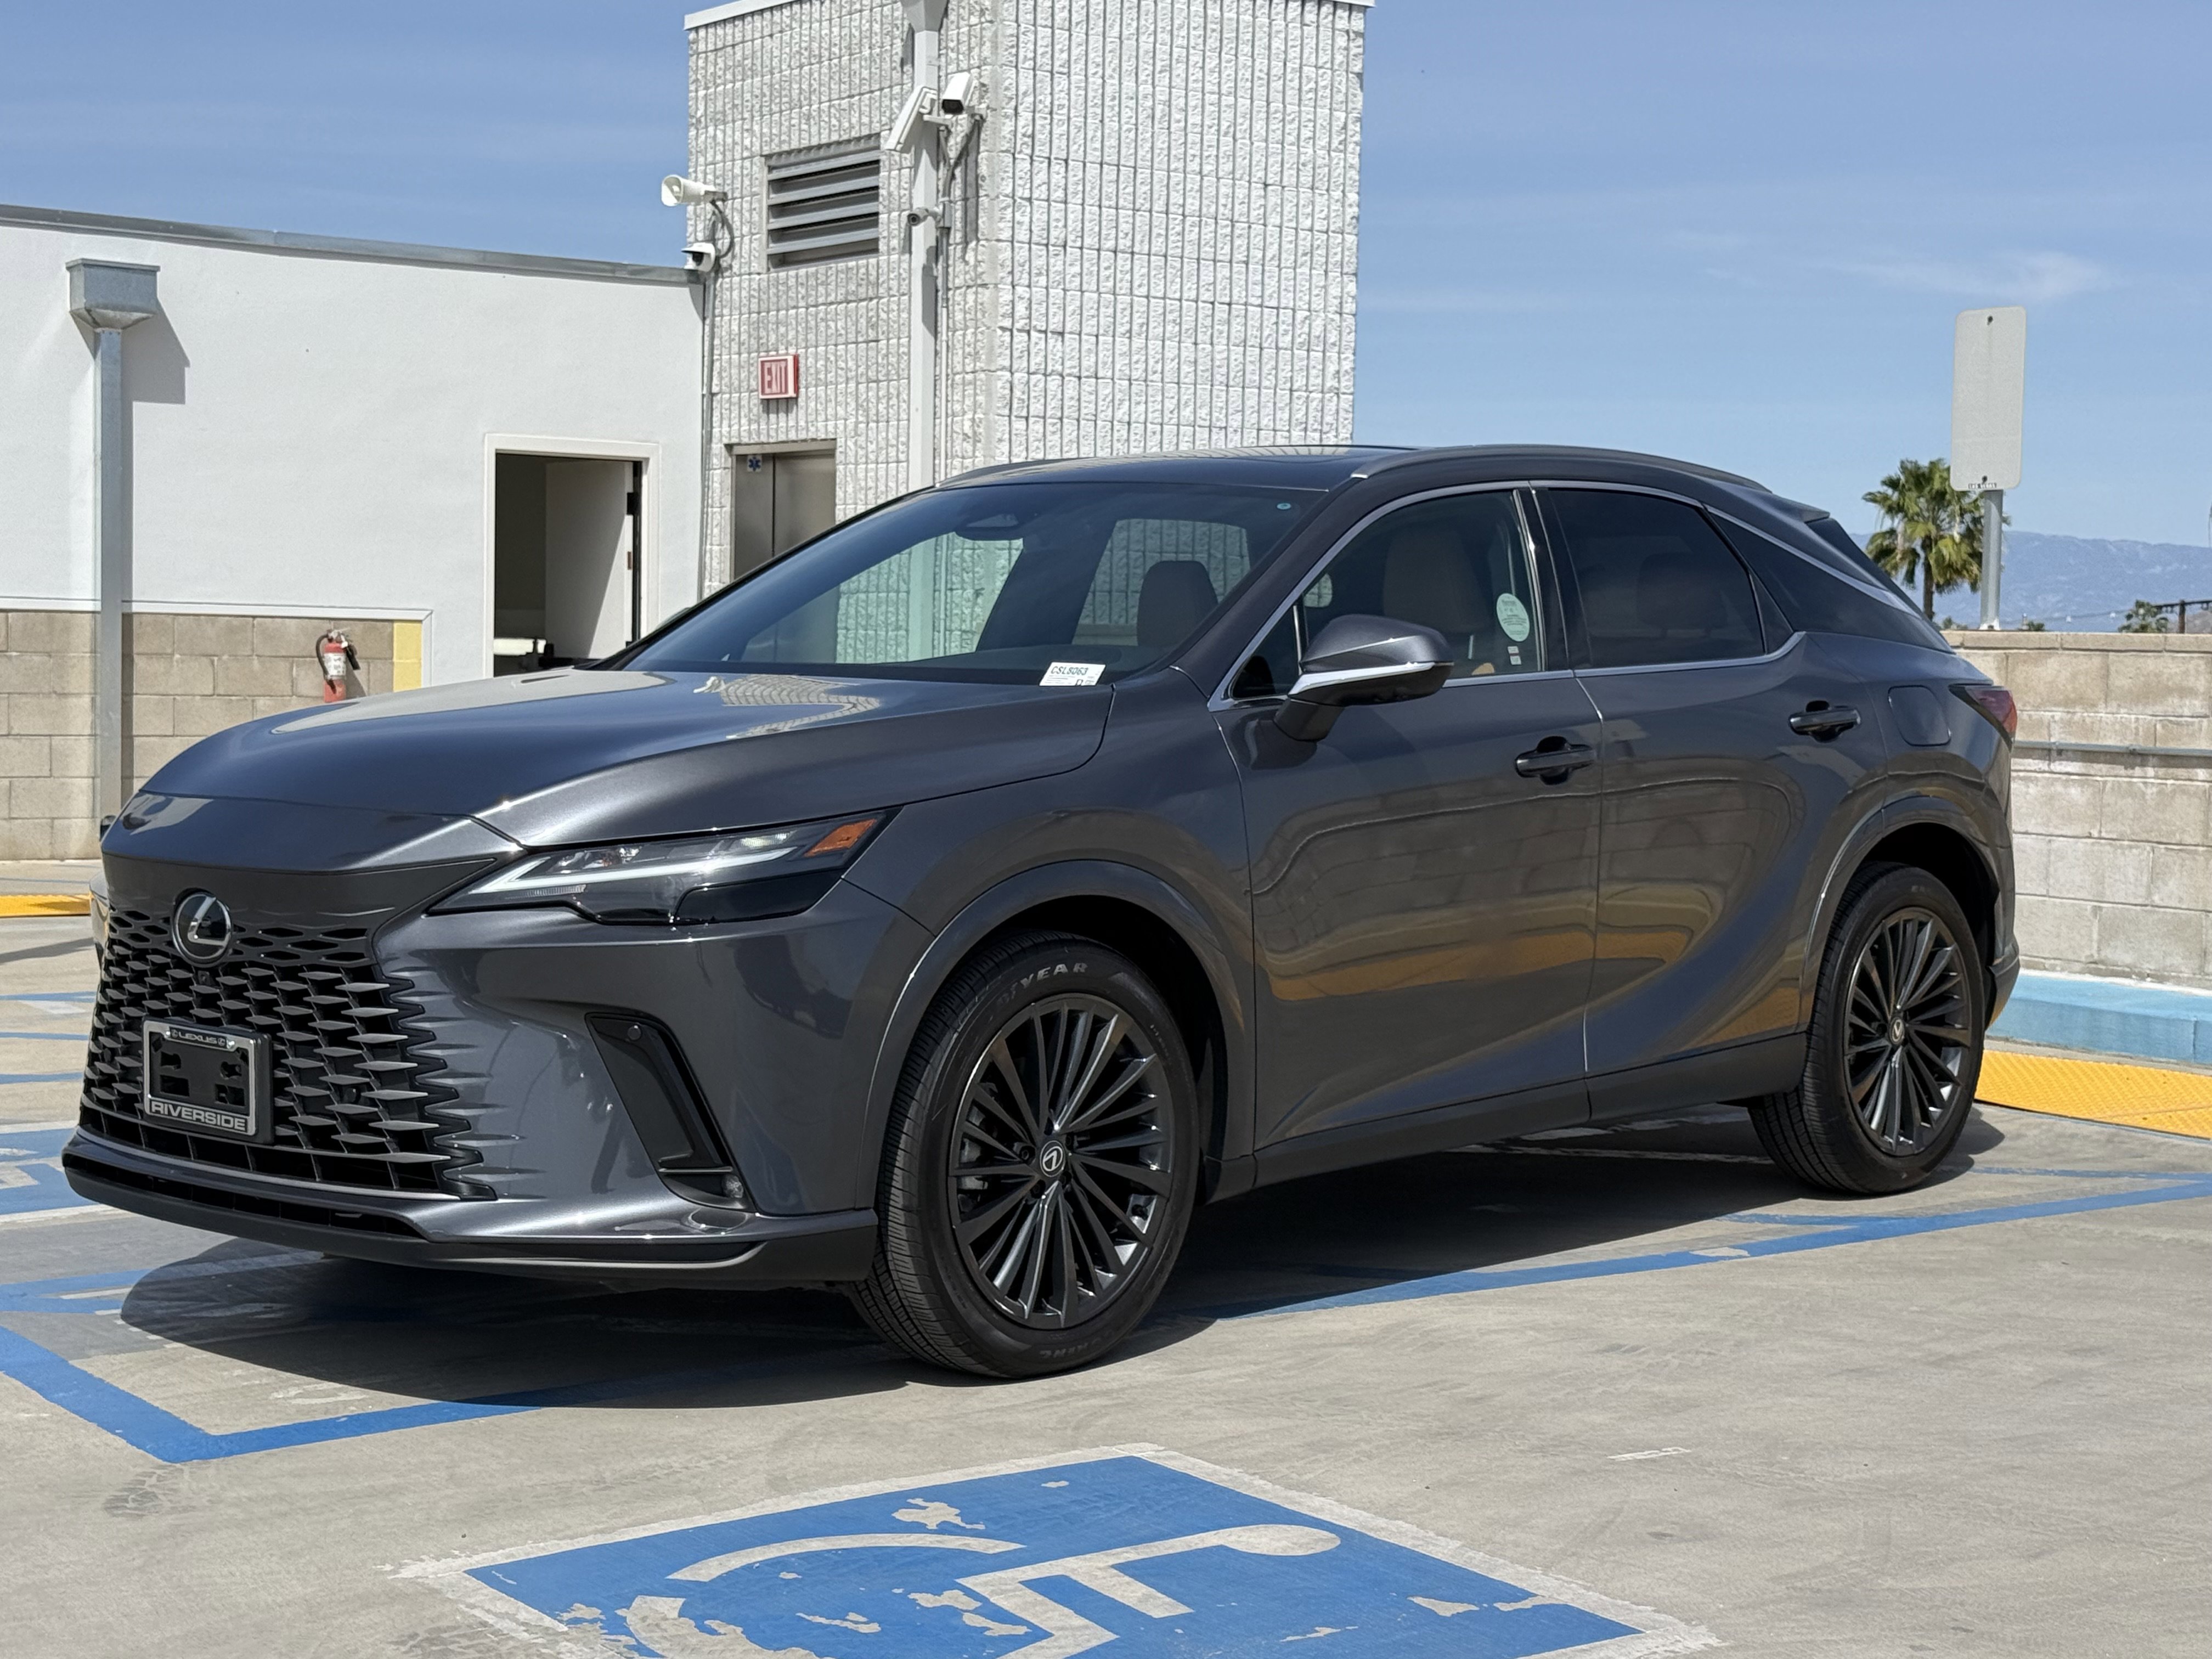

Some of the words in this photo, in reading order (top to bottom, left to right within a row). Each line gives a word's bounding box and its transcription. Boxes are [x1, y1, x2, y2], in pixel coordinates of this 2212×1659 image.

[764, 361, 786, 393] EXIT
[179, 1032, 217, 1044] LEXUS
[151, 1101, 246, 1131] RIVERSIDE
